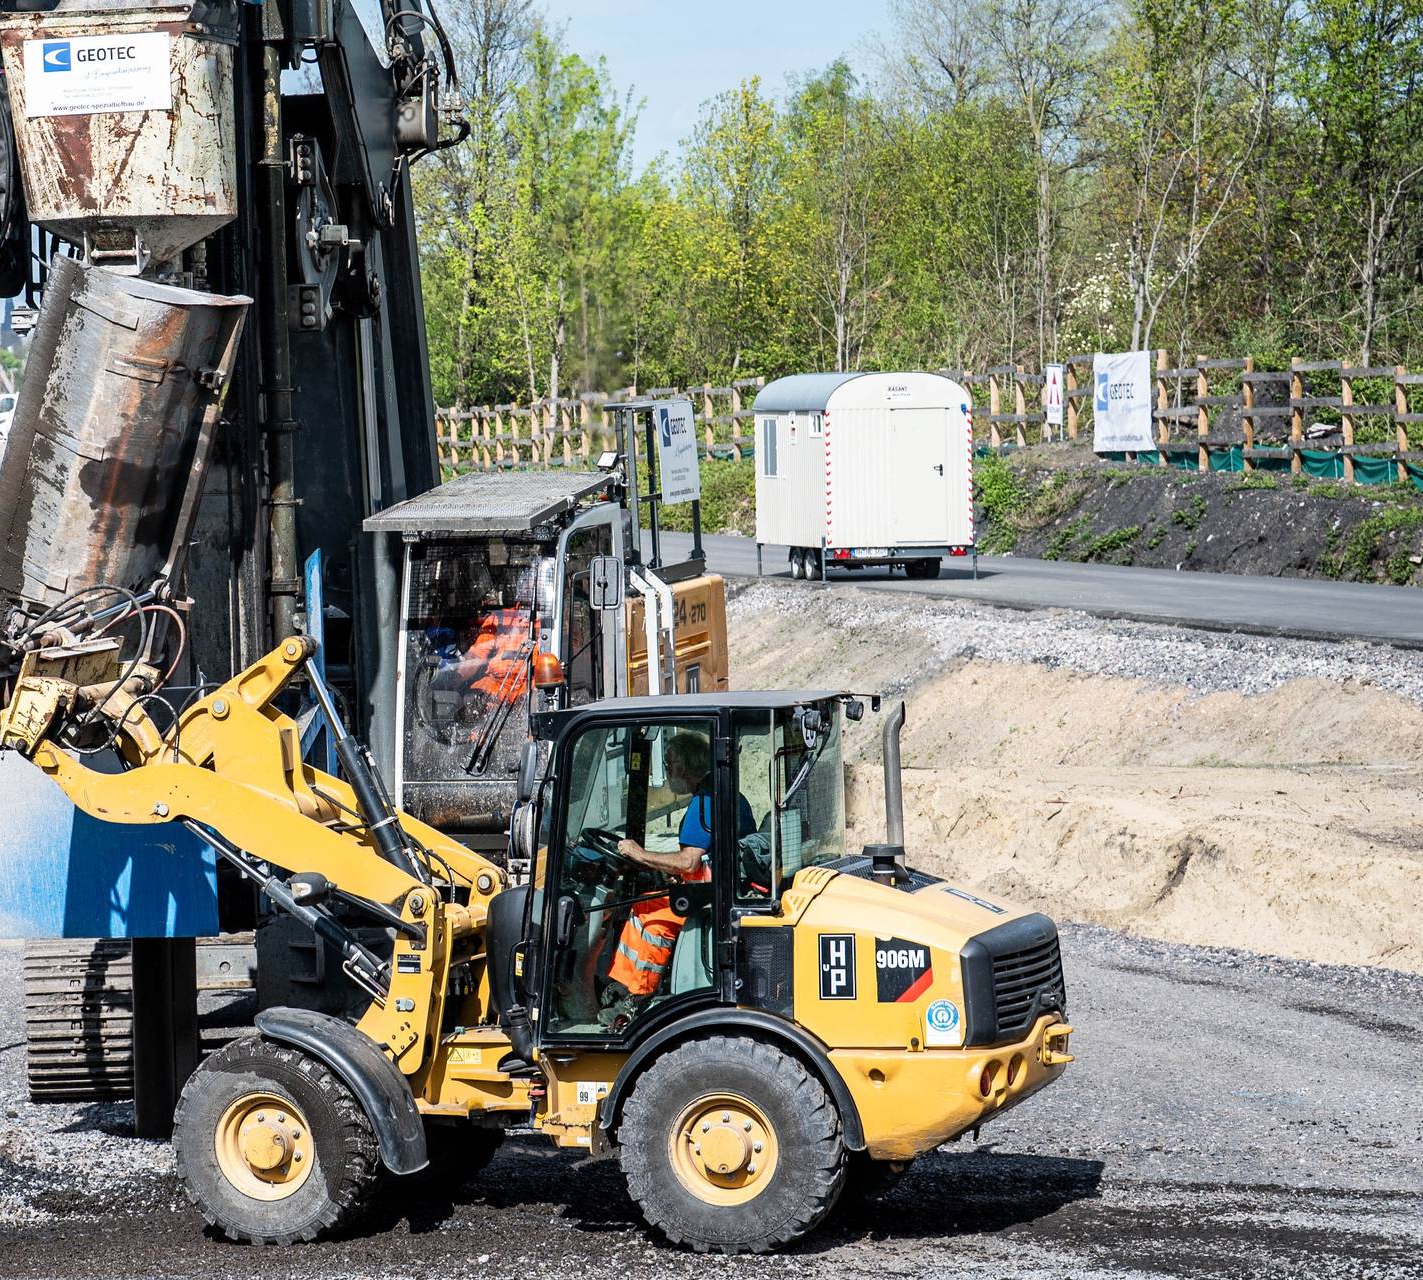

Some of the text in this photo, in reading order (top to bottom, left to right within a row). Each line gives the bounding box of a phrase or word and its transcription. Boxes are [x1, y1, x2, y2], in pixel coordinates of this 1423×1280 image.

[77, 46, 136, 62] GEOTEC
[1110, 383, 1134, 400] GEOTEC
[670, 417, 687, 436] GEOTEC
[877, 950, 925, 968] 906M
[580, 1091, 589, 1102] 99
